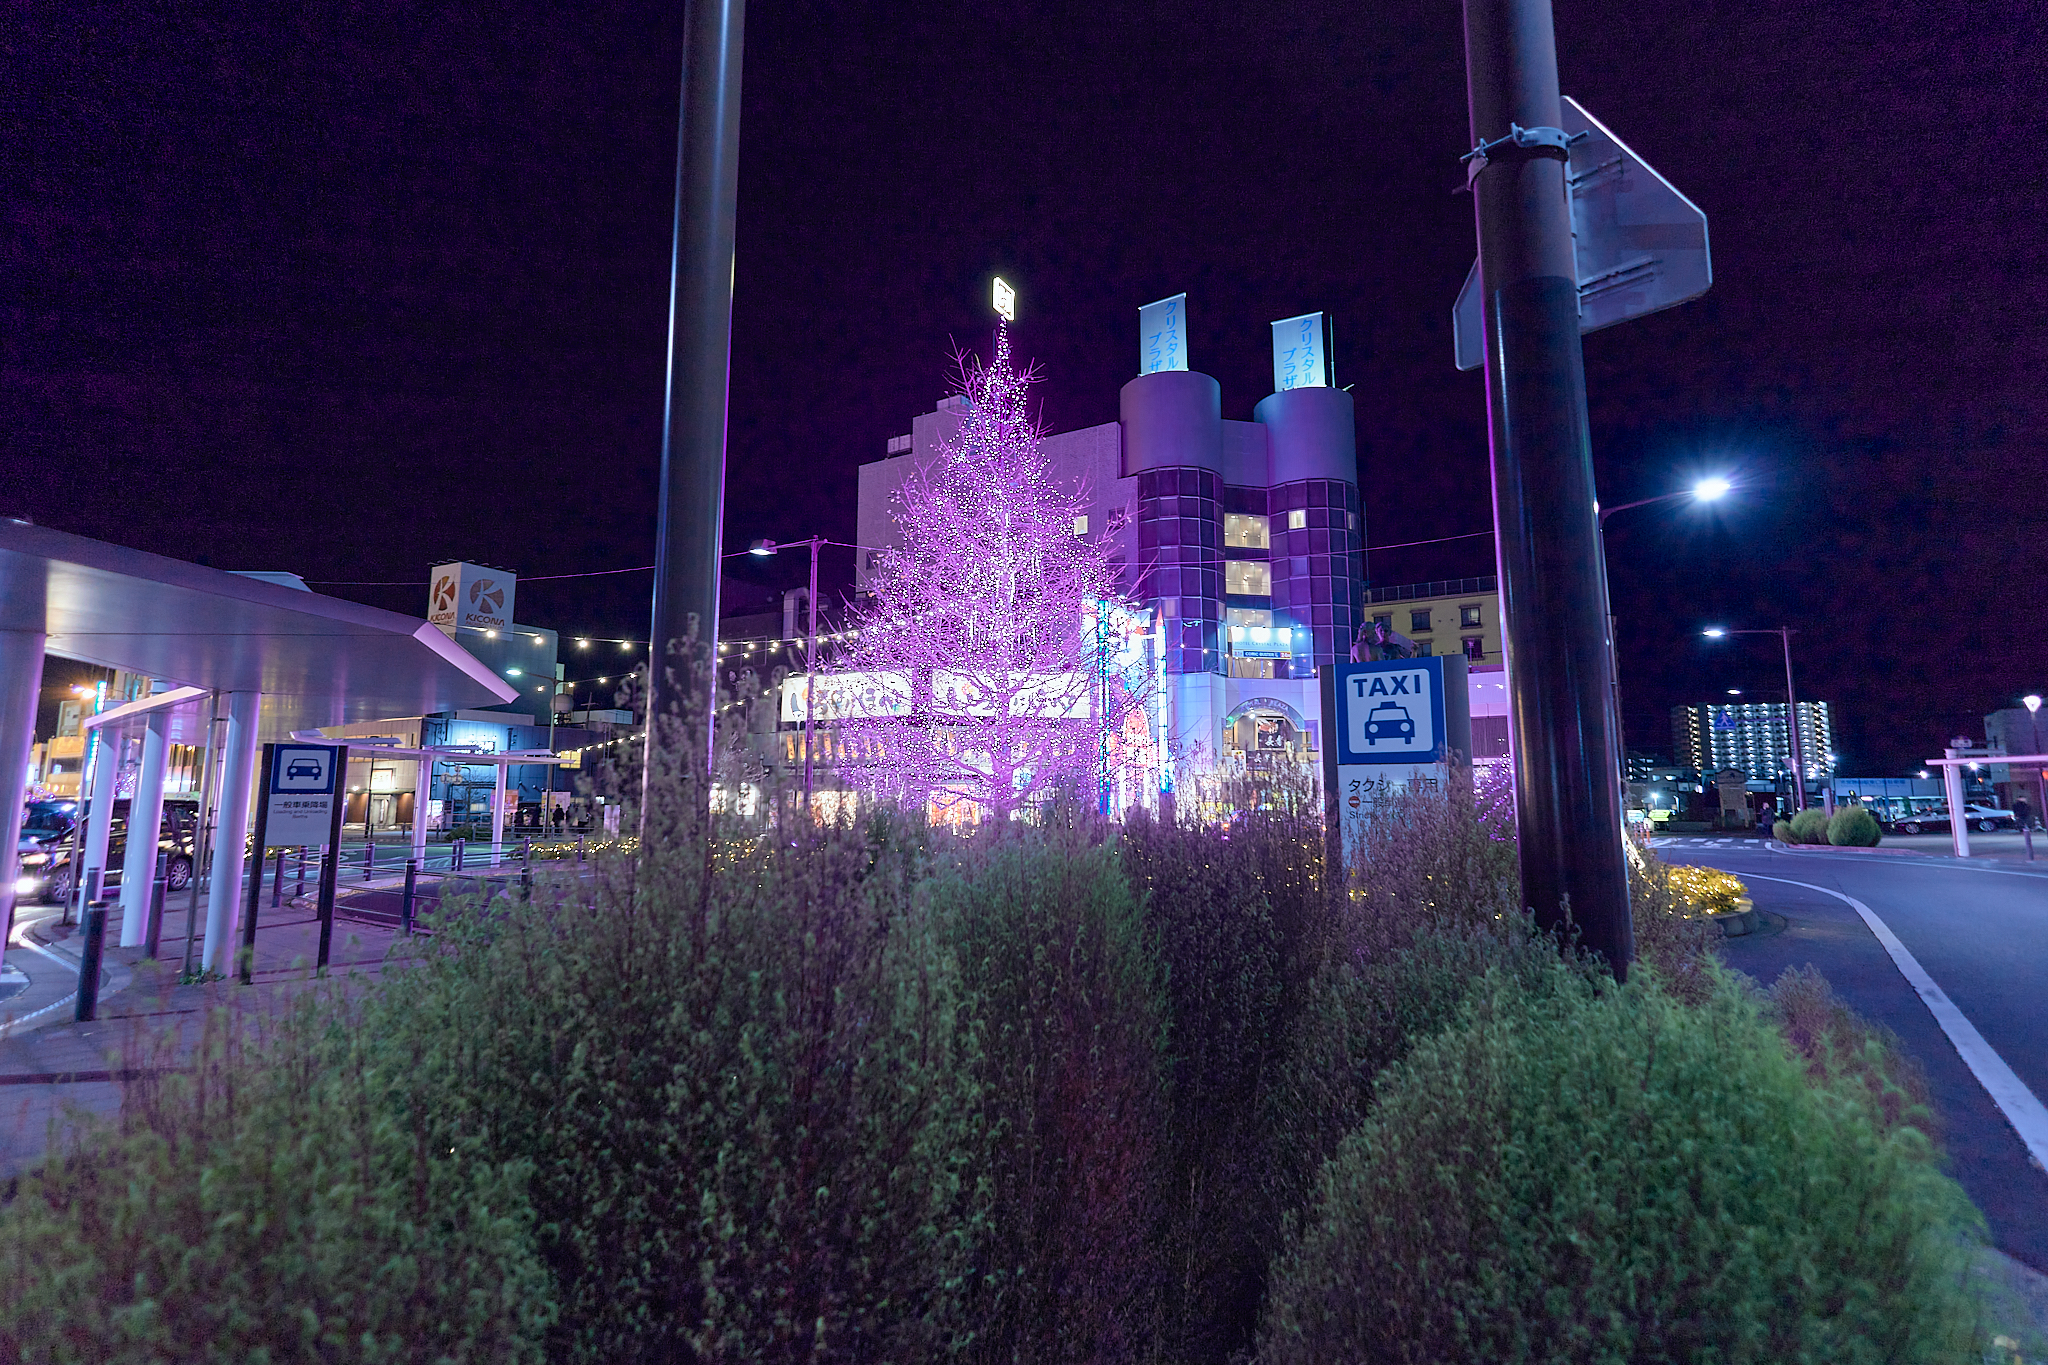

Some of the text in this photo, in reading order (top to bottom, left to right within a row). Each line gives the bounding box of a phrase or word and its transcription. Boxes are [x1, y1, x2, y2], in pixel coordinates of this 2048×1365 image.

[1148, 332, 1163, 372] プラザ
[1165, 301, 1179, 371] クリスタル
[1300, 319, 1316, 386] クリスタル
[1283, 347, 1298, 389] プラザ
[430, 612, 455, 622] KICONA
[465, 613, 505, 626] KICONA
[1353, 674, 1421, 697] TAXI
